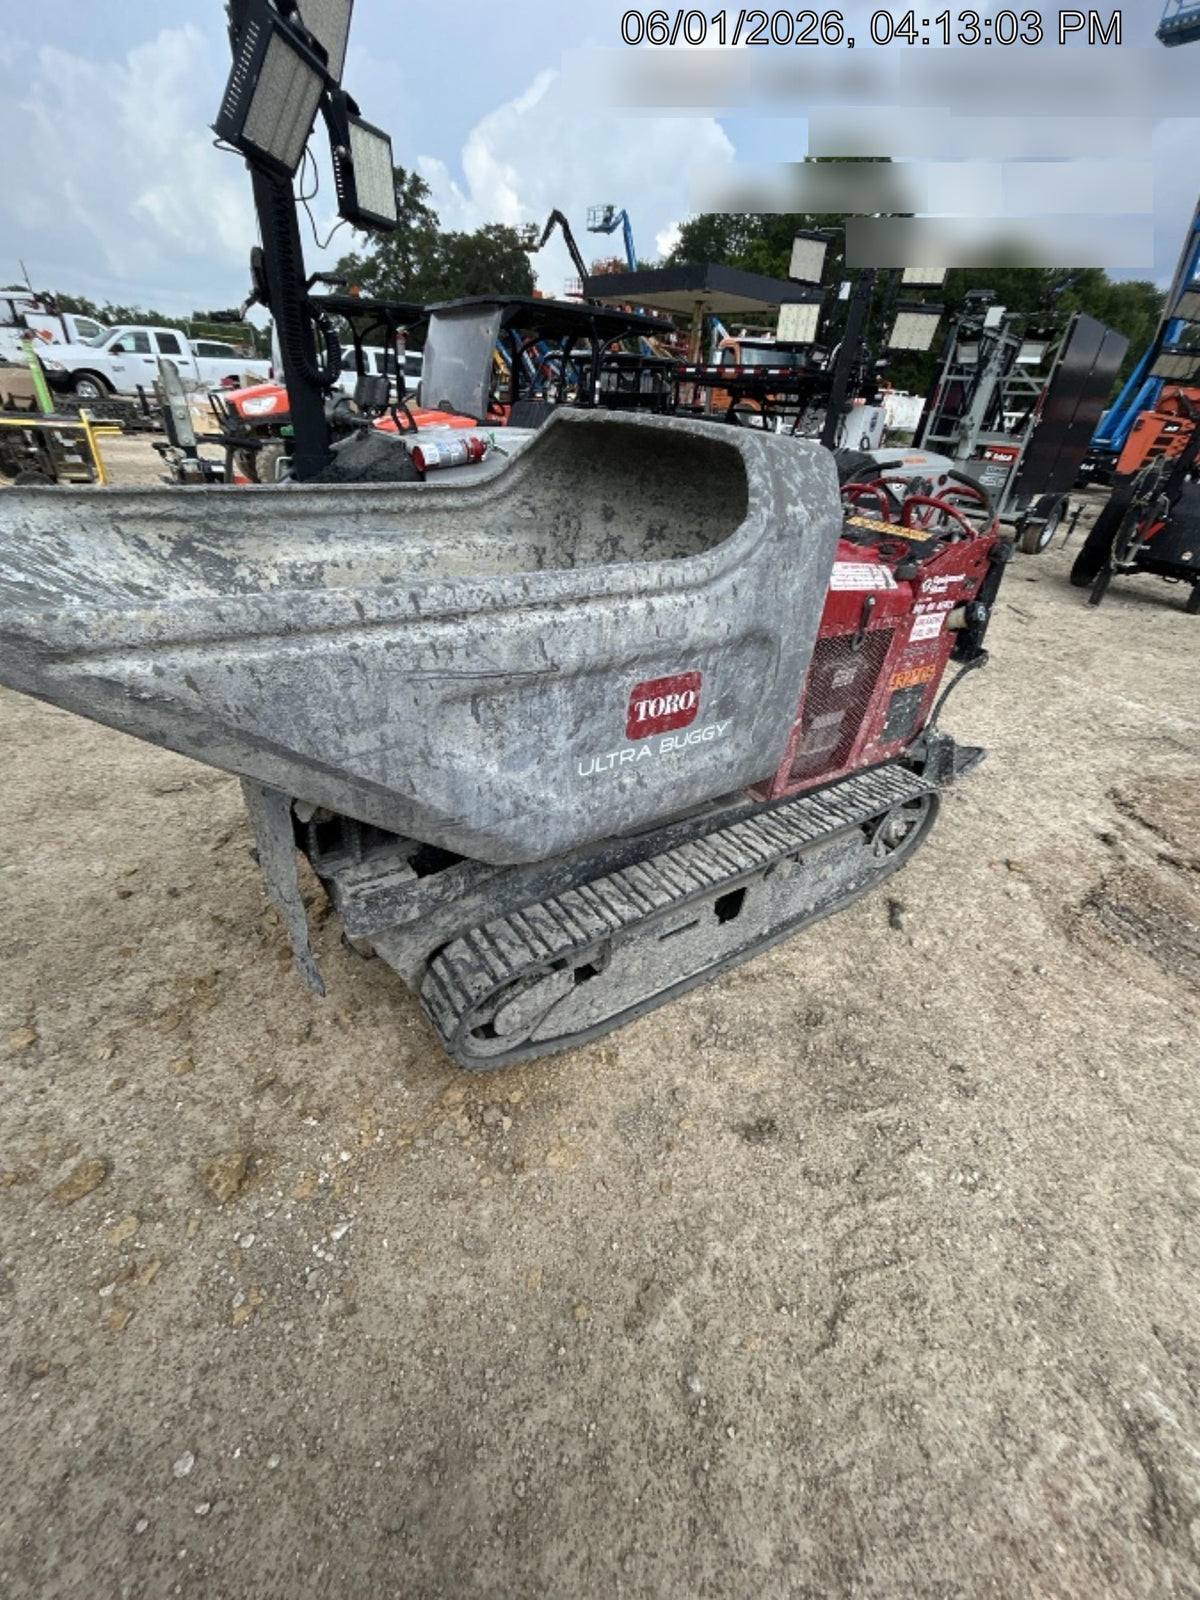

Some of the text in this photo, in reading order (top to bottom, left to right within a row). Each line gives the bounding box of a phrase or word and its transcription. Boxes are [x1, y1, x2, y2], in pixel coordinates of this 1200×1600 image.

[635, 689, 696, 723] TORO
[578, 716, 735, 776] ULTRA BUGGY
